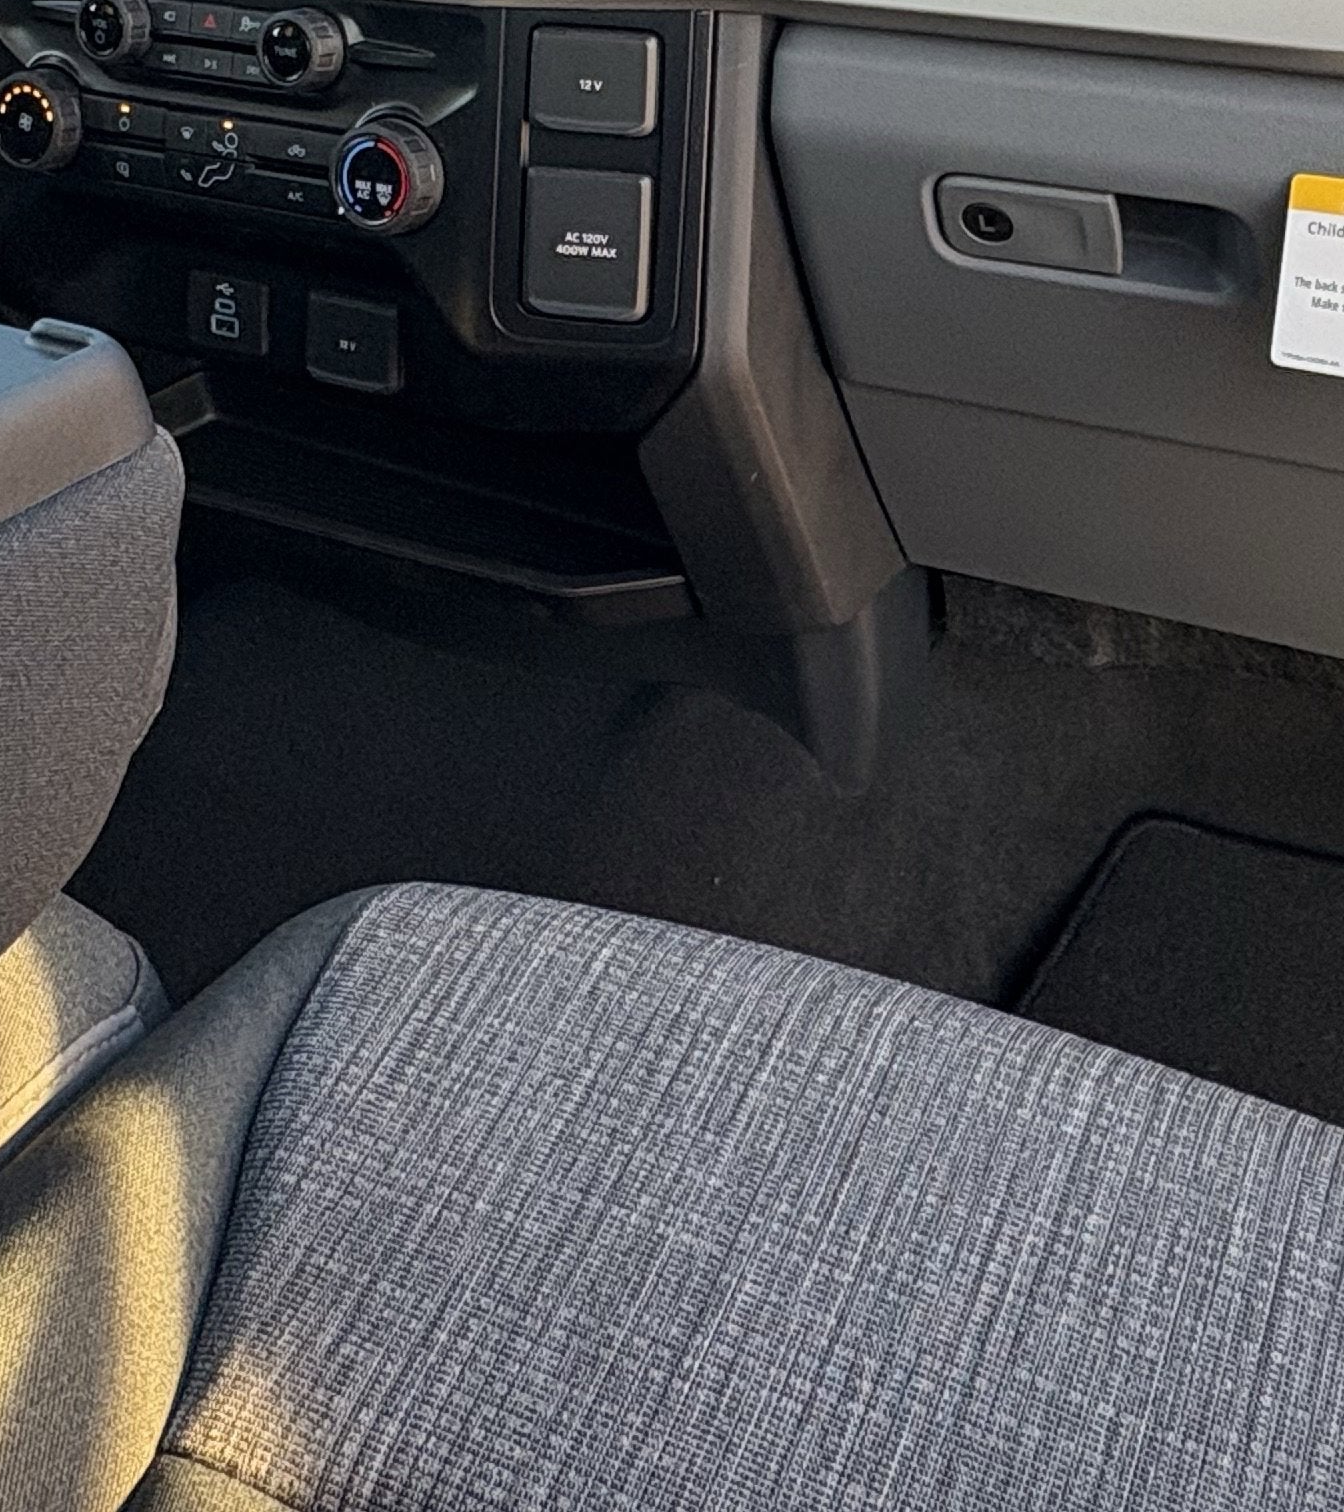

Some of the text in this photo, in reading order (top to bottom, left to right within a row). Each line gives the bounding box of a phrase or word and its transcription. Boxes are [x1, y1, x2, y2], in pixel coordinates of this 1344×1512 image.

[579, 78, 604, 92] 12 V
[564, 232, 610, 246] AC 120V
[556, 244, 618, 258] 400W MAX
[1294, 276, 1312, 290] The
[1315, 278, 1338, 293] back
[1311, 296, 1340, 312] Make
